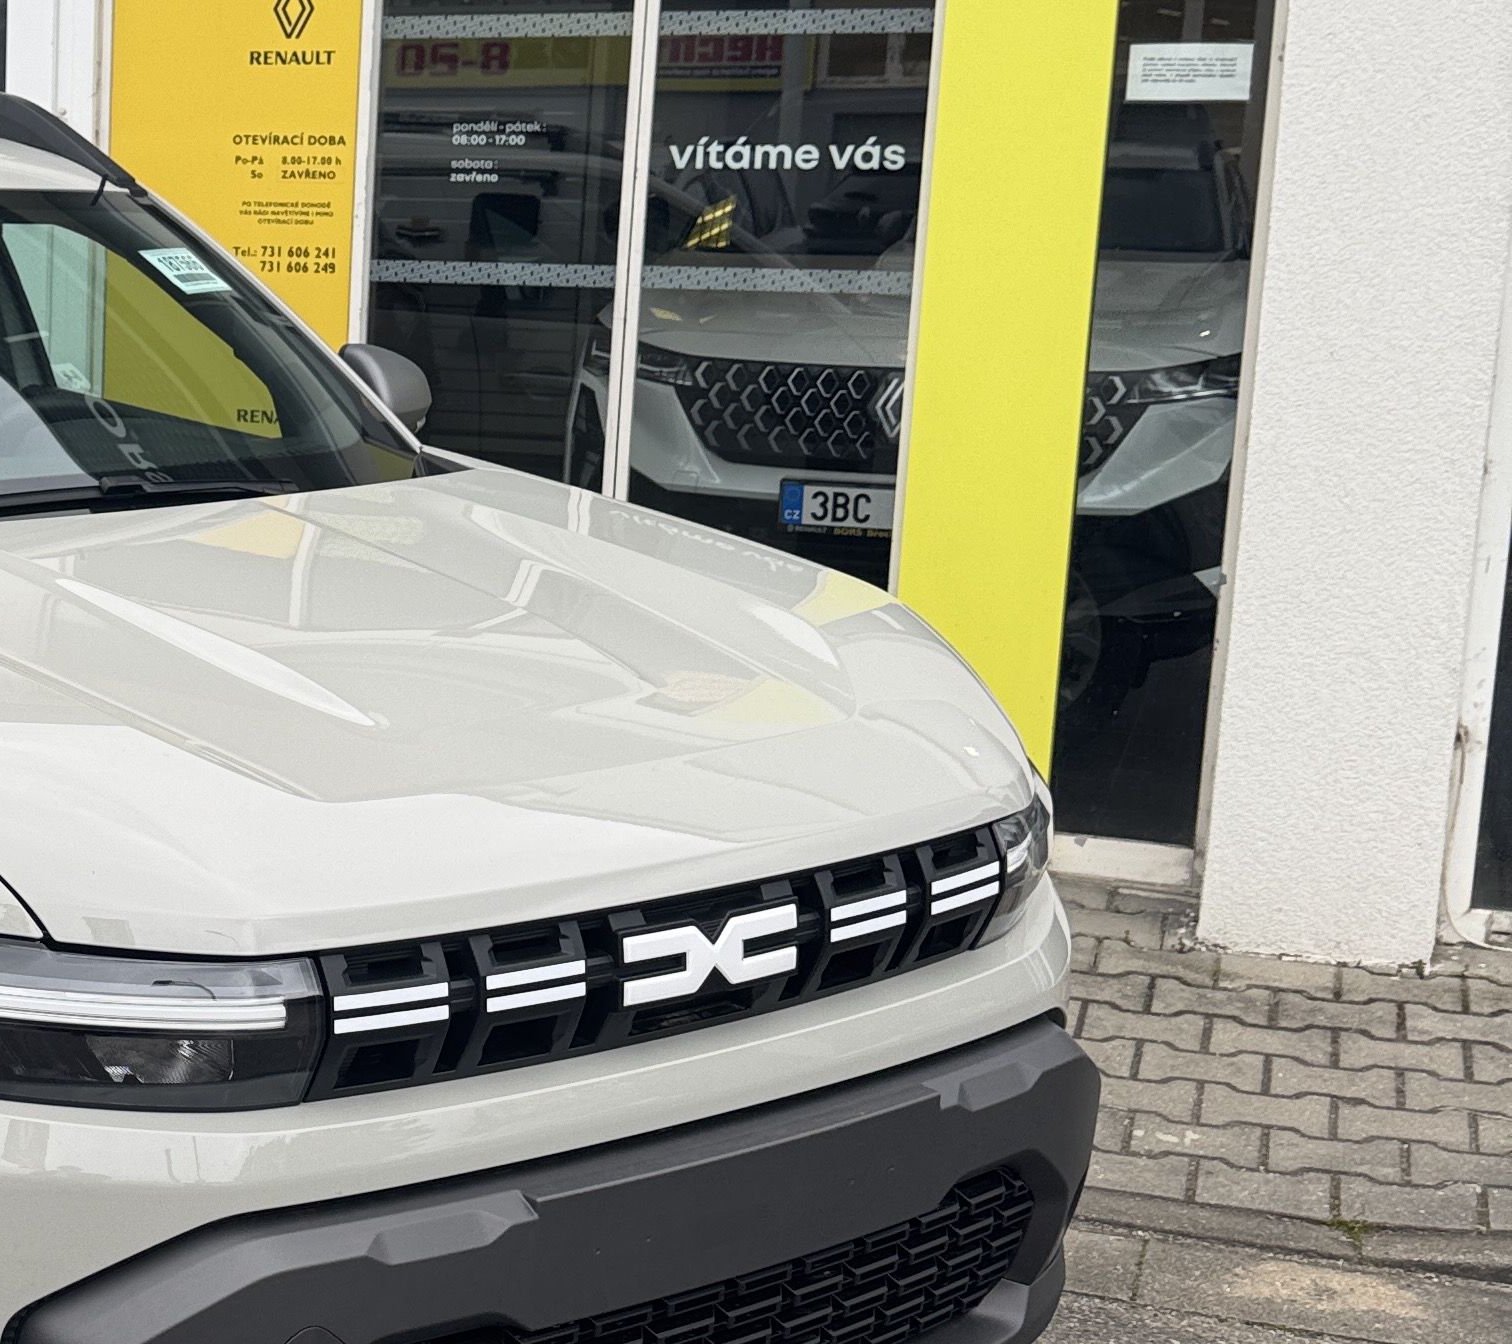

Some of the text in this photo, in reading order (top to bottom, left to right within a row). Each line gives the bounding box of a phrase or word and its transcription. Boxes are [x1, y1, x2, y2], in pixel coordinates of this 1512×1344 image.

[249, 50, 336, 66] RENAULT
[232, 131, 346, 146] OTEVÍRACÍ DOBA
[494, 134, 526, 146] 17:00
[668, 136, 906, 171] vítáme vás
[250, 168, 337, 180] So ZAVŘENO
[449, 171, 499, 183] zavřeno
[260, 245, 282, 258] 731
[287, 246, 310, 258] 606
[314, 247, 336, 259] 241
[259, 261, 336, 274] 731 606 249
[236, 409, 279, 425] REN
[810, 490, 872, 524] 3BC
[784, 509, 801, 521] CZ
